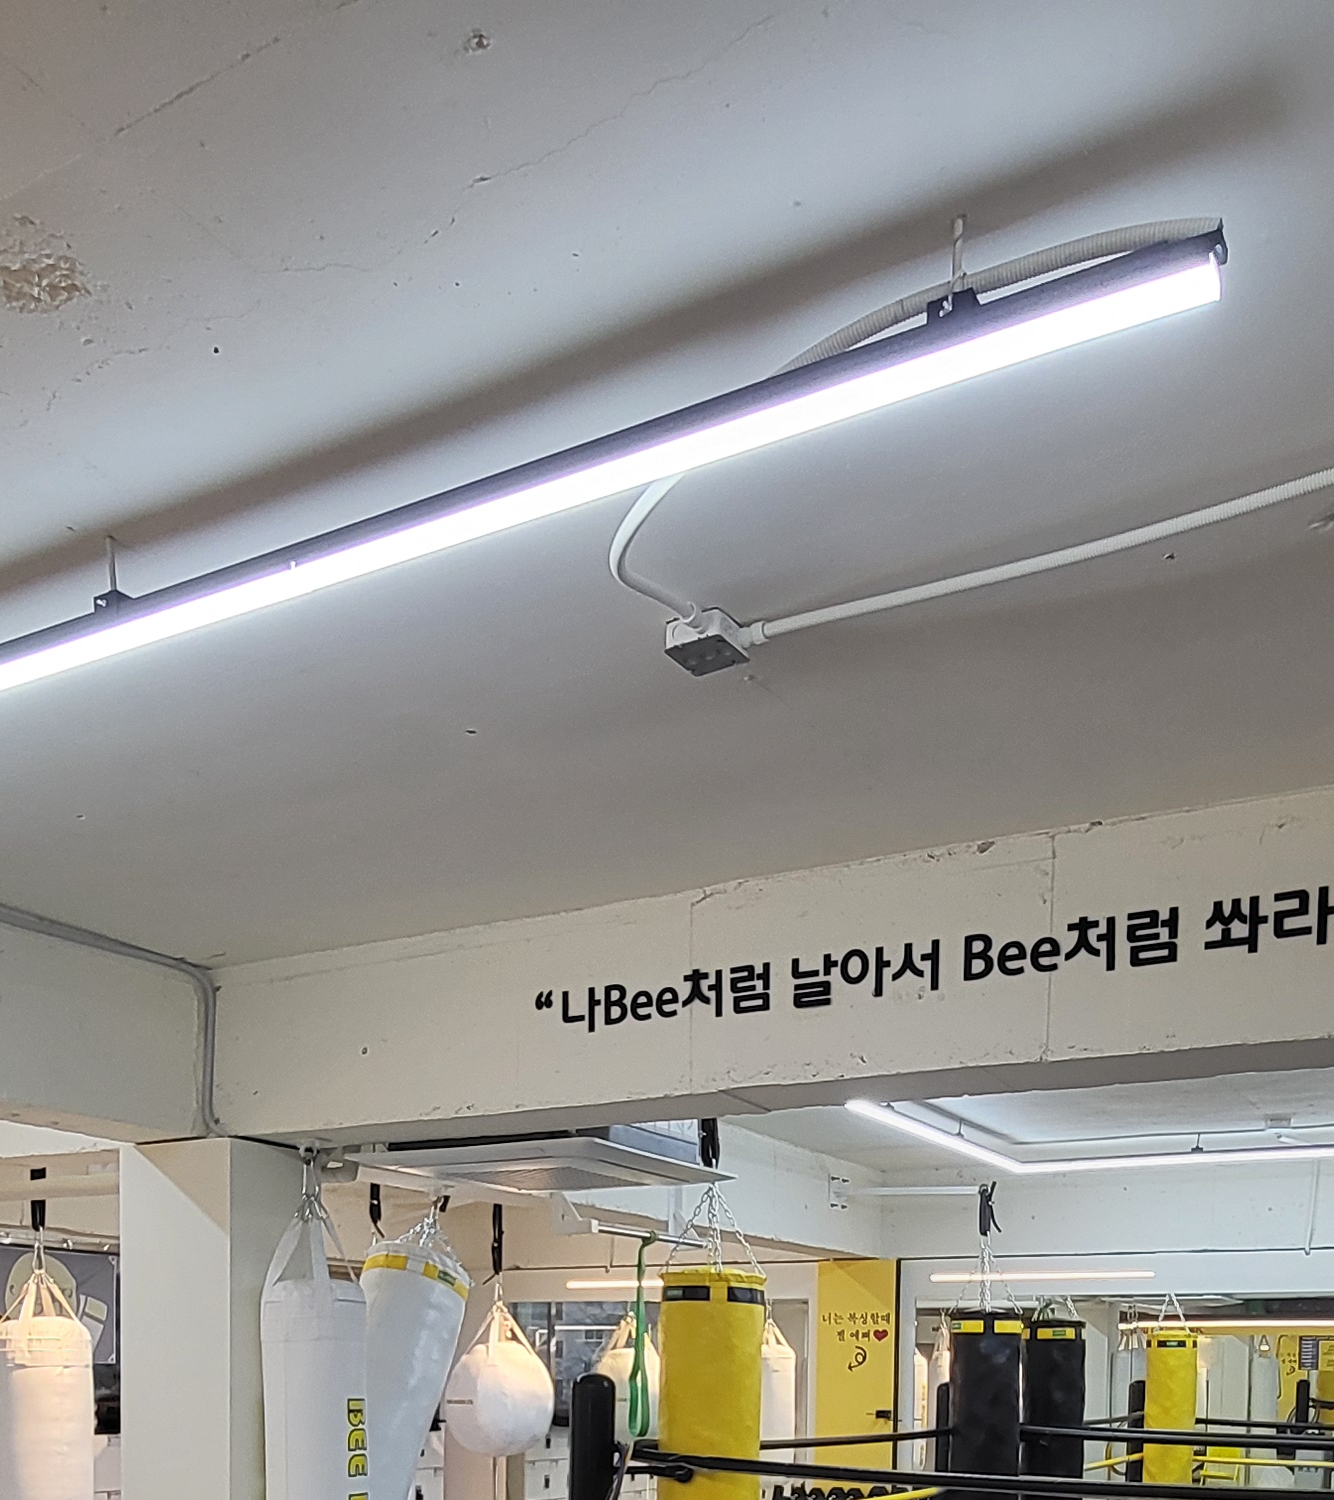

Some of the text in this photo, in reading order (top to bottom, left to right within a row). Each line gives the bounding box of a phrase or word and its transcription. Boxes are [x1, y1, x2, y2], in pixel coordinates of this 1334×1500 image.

[791, 938, 941, 1009] 날아서
[963, 906, 1181, 982] Bee처럼
[822, 1312, 844, 1325] 너는
[347, 1398, 369, 1478] BEE
